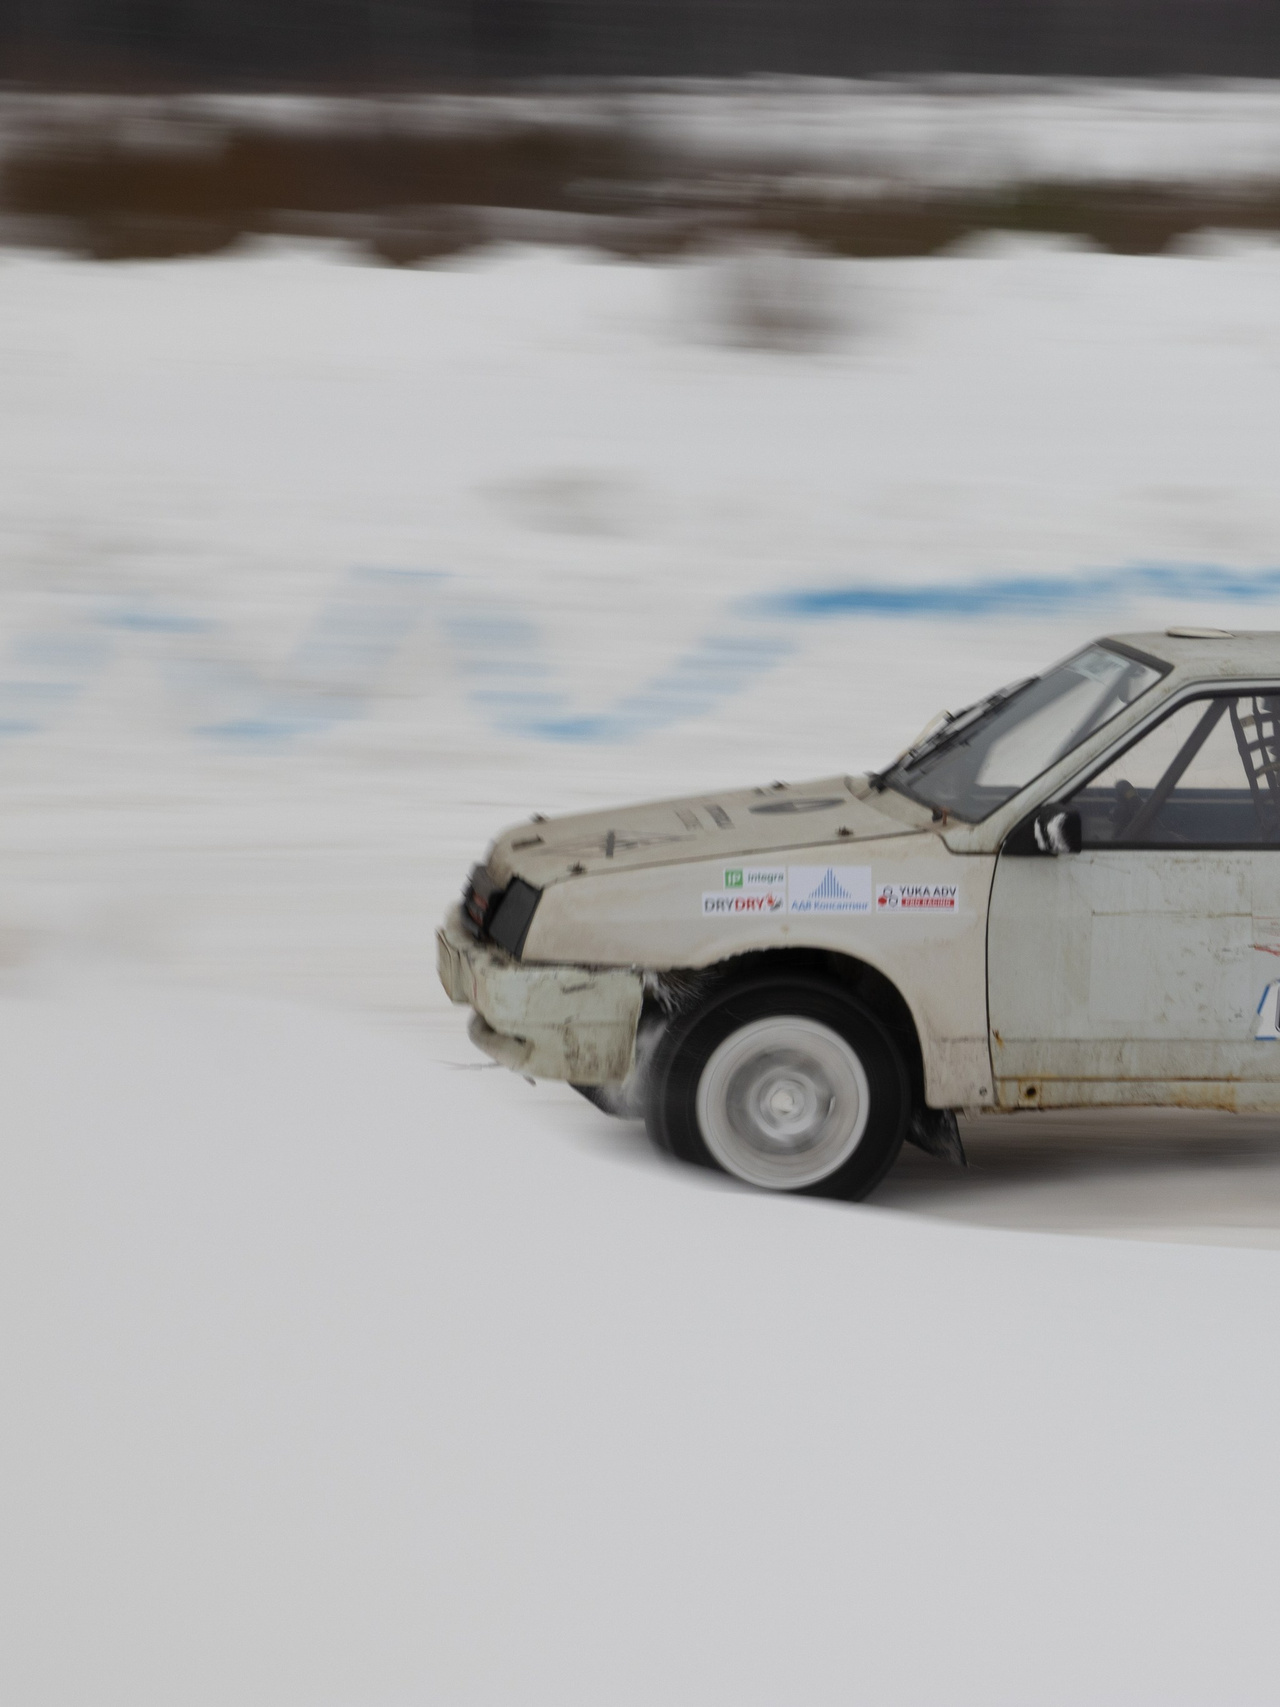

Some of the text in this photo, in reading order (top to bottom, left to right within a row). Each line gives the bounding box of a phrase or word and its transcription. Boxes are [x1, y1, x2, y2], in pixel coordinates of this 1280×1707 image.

[899, 885, 957, 897] YUKA ADV
[704, 897, 765, 912] DRYDRY
